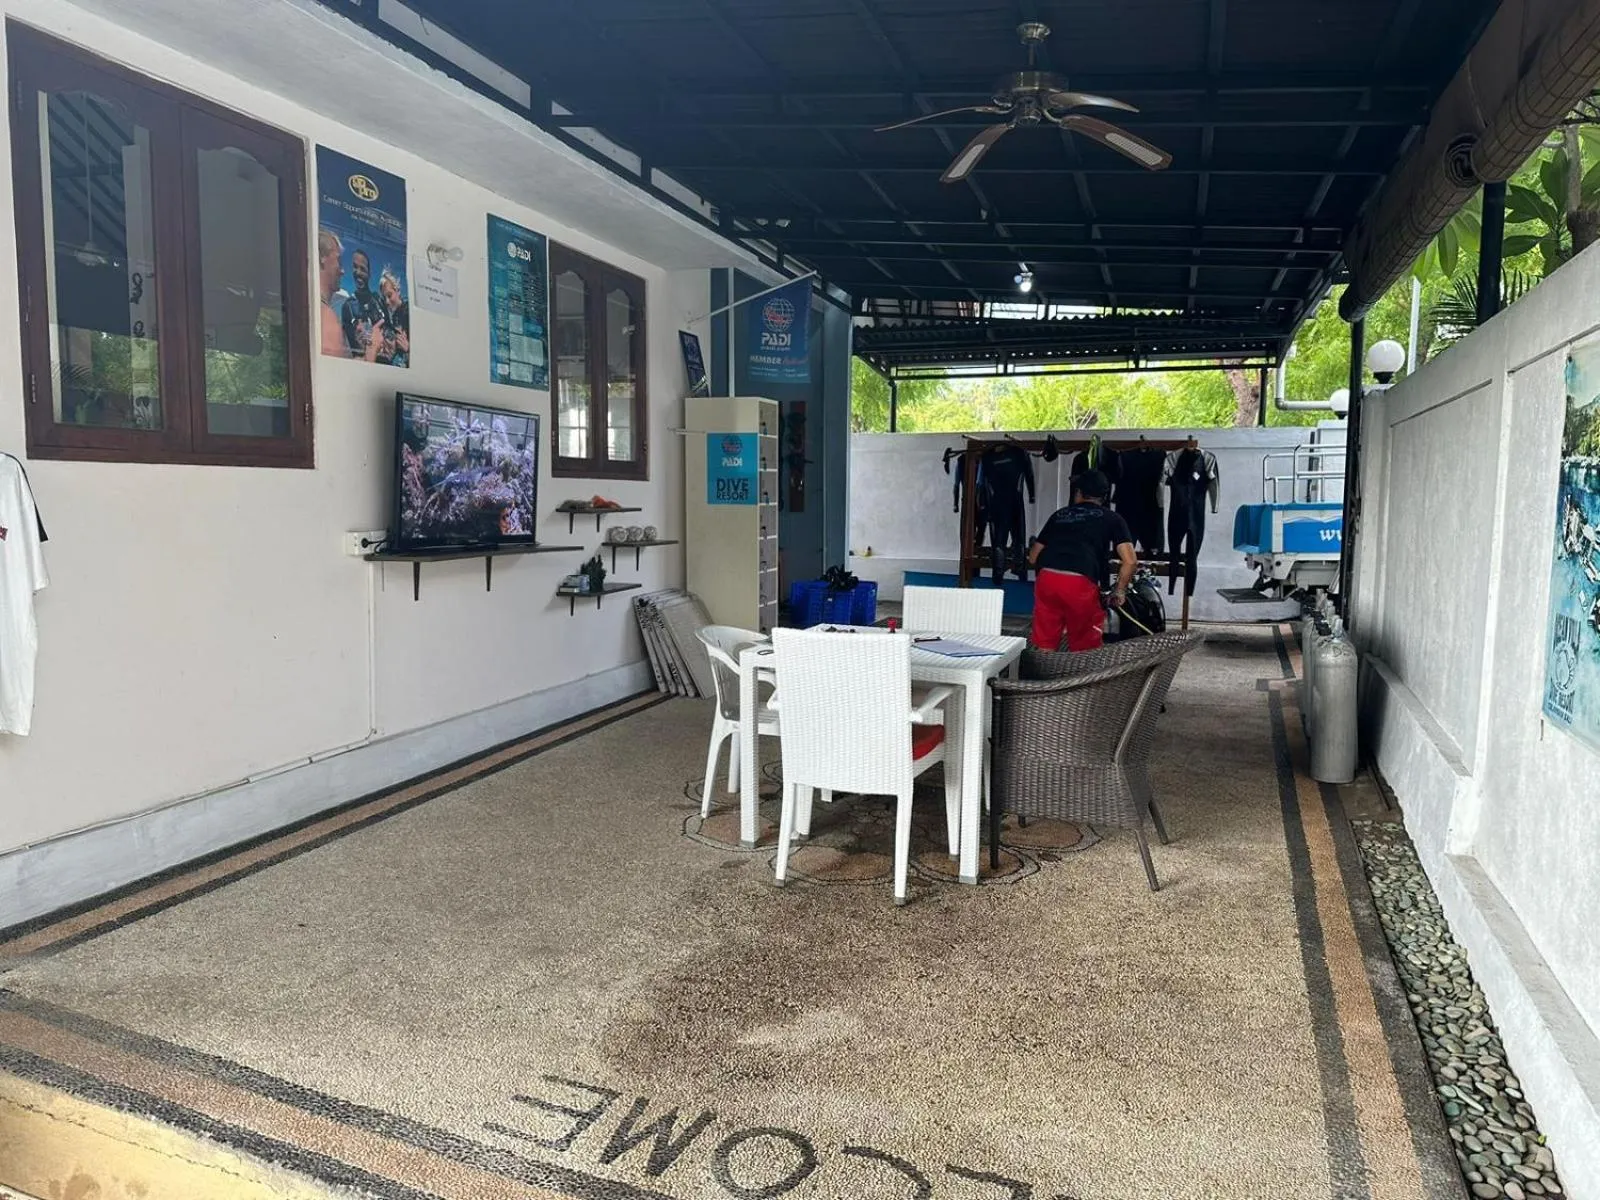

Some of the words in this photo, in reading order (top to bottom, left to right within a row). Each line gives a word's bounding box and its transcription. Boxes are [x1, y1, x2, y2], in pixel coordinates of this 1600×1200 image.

[516, 246, 531, 262] PADI
[761, 332, 792, 346] PADI
[750, 355, 782, 364] MEMBER
[722, 457, 743, 467] PADI
[716, 478, 749, 492] DIVE
[716, 491, 749, 501] RESORT
